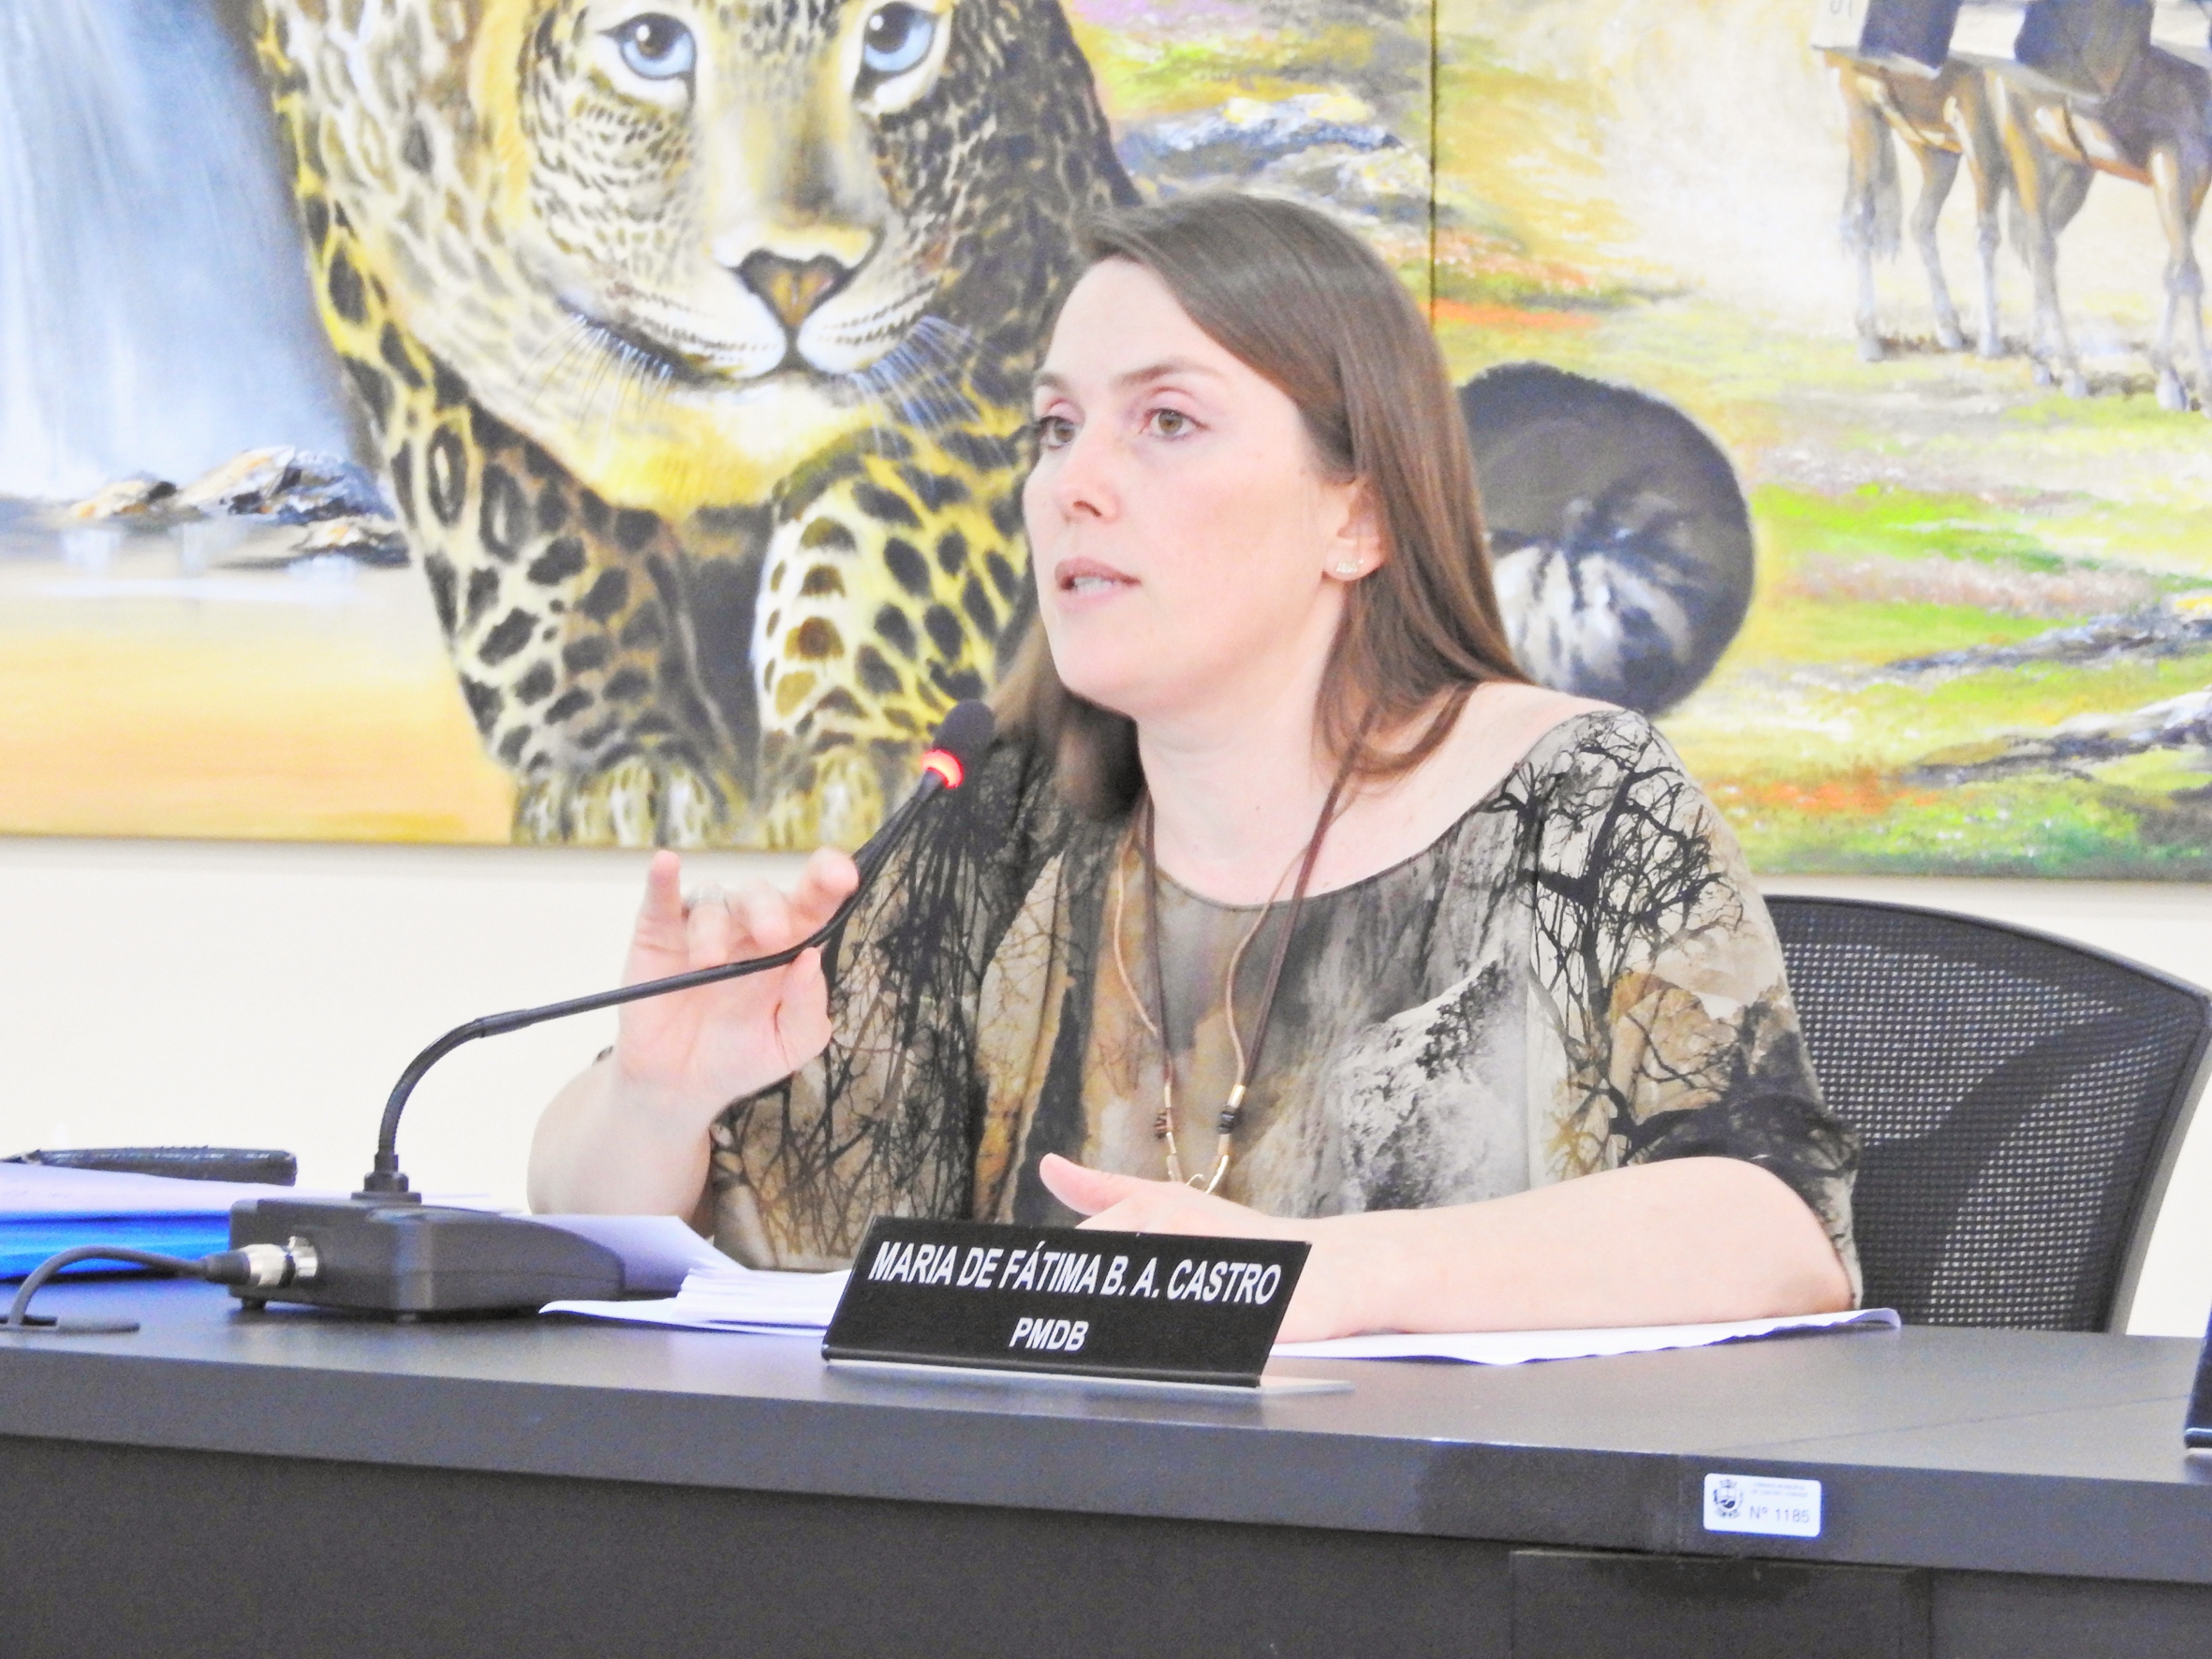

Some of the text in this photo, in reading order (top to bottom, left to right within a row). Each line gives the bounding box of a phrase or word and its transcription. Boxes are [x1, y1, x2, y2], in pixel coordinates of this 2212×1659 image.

[868, 1240, 1282, 1305] MARIA DE FÁTIMA B. A. CASTRO
[1009, 1316, 1090, 1352] PMDB
[1775, 1508, 1810, 1523] 1185
